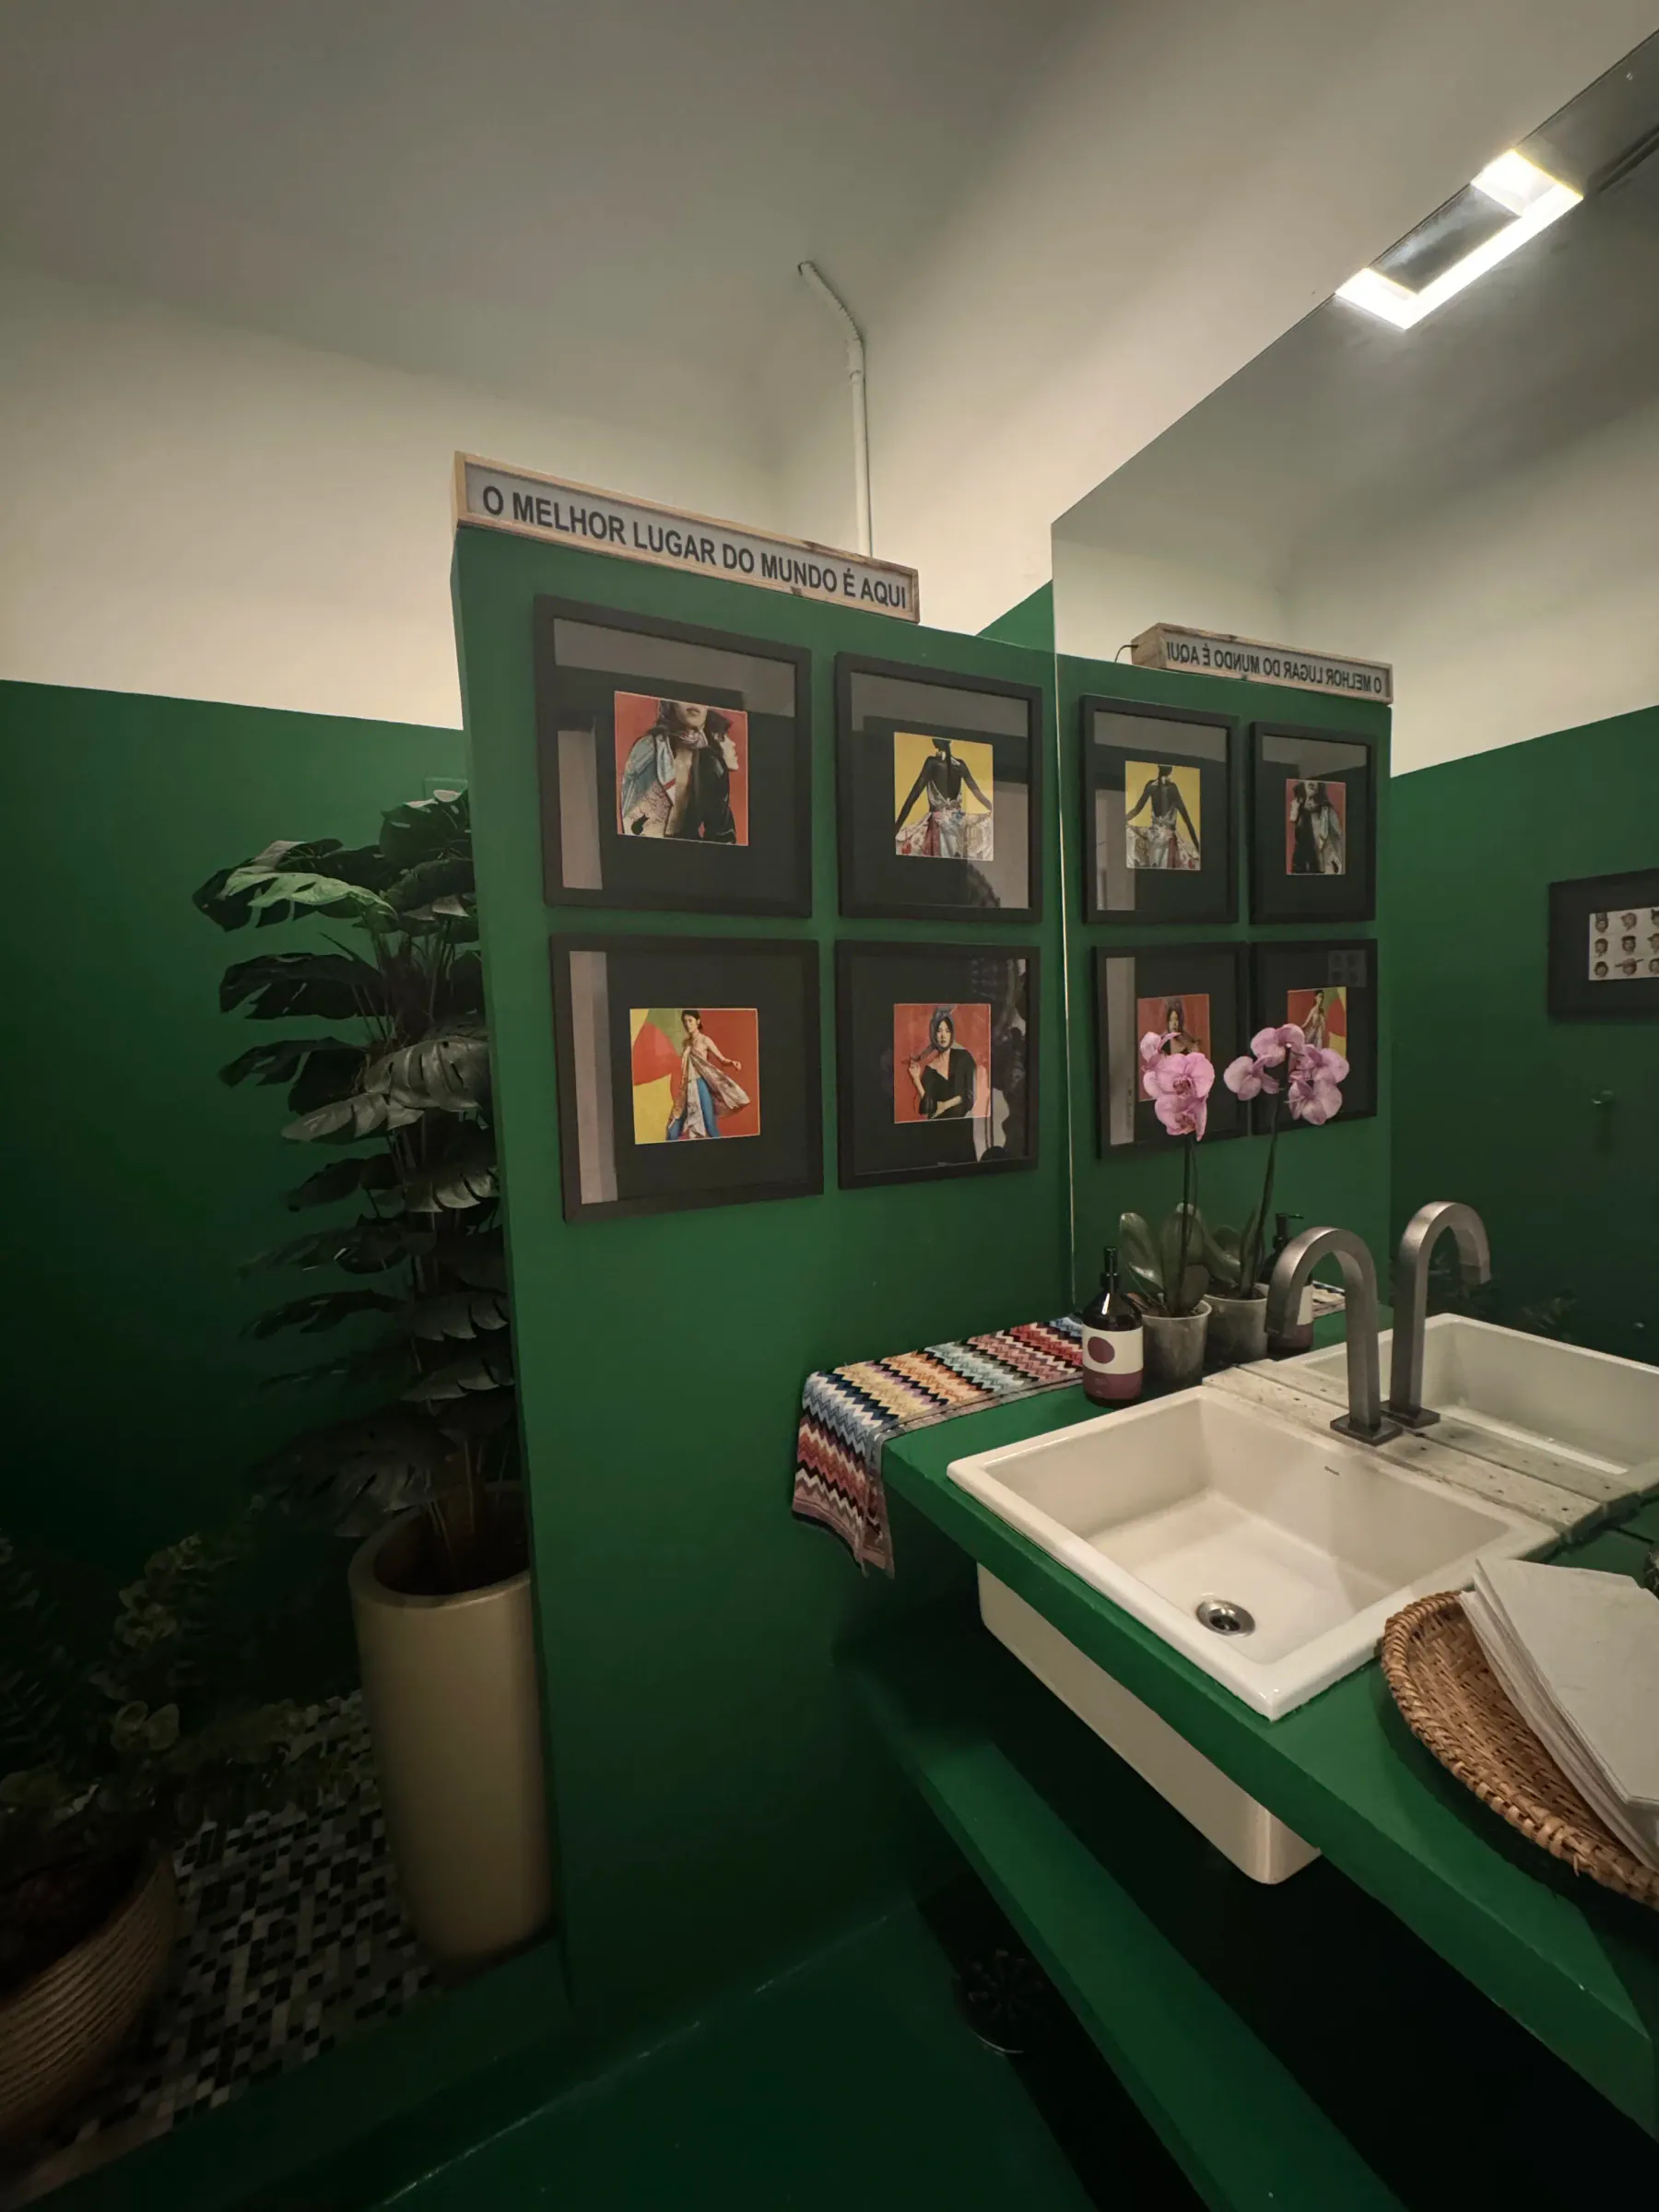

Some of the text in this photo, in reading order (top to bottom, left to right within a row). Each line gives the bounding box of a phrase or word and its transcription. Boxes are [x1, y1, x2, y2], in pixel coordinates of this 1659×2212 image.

[483, 486, 906, 609] O MELHOR LUGAR DO MUNDO É AQUI
